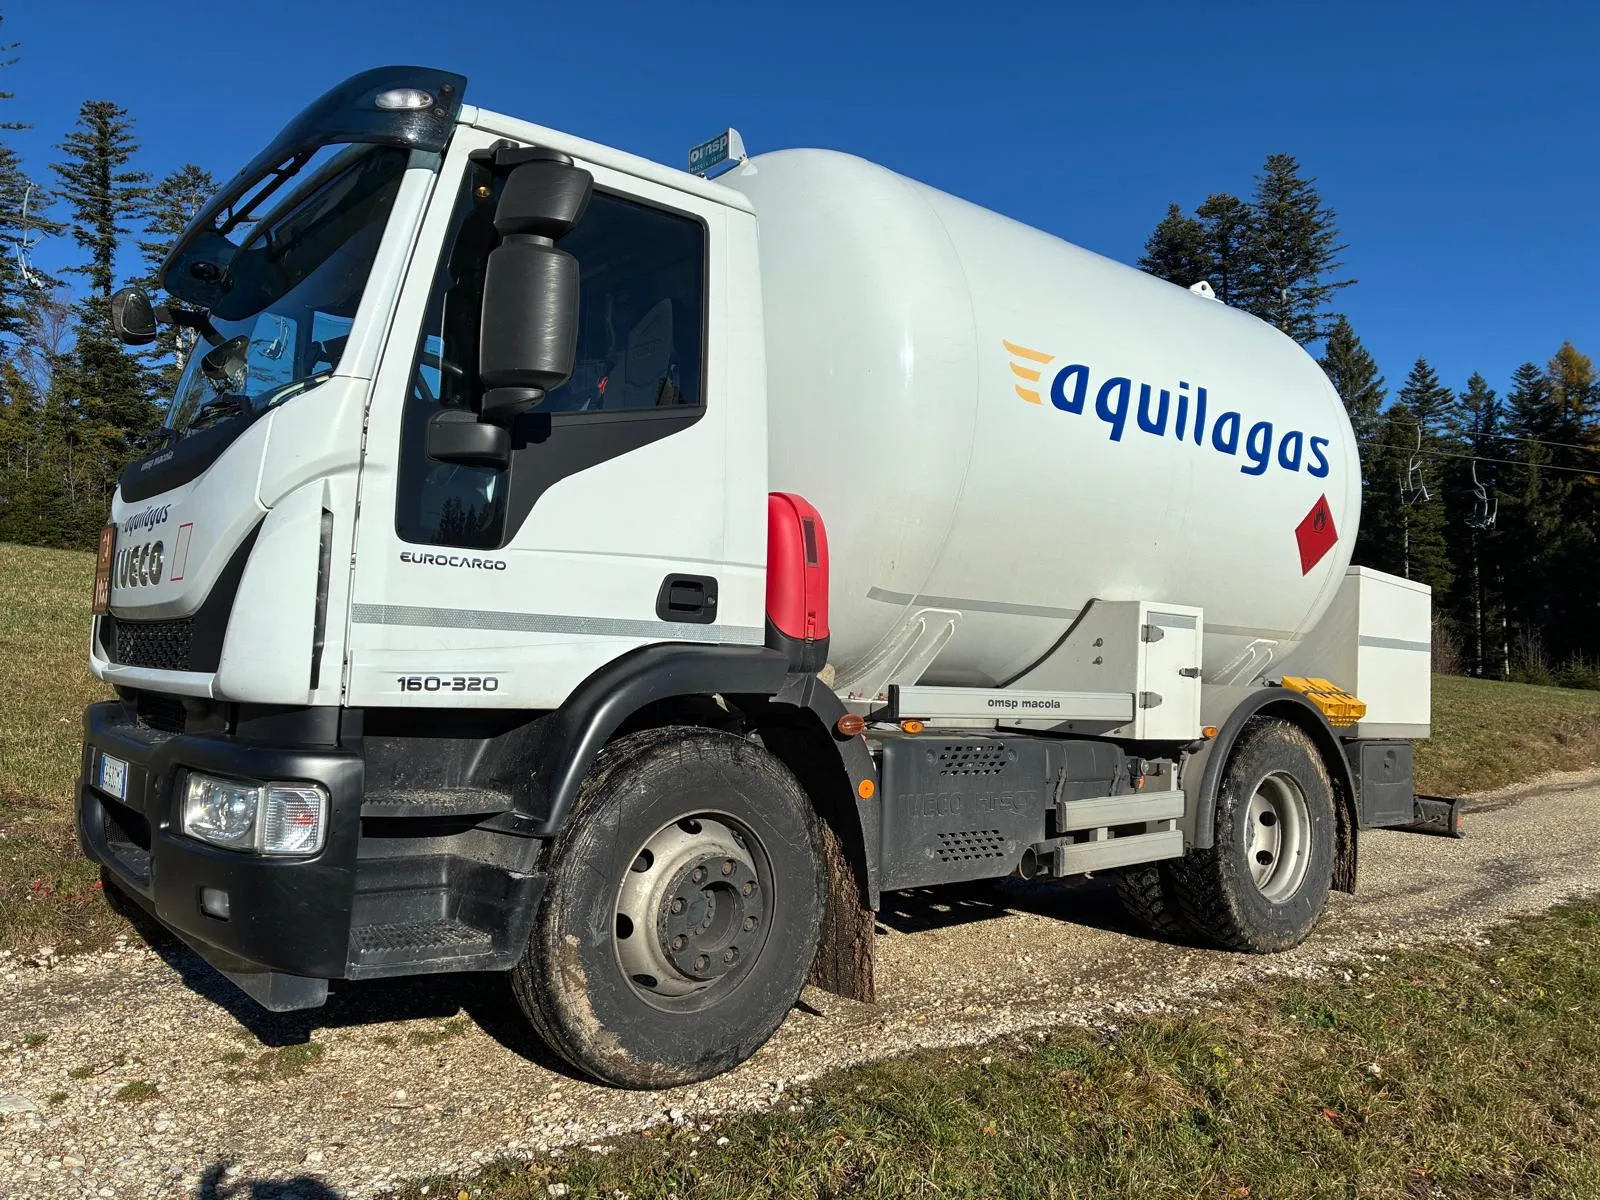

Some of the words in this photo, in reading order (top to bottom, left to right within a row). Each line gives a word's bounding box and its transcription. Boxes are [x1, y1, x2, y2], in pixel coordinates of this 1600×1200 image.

[690, 134, 728, 163] omsp
[1049, 363, 1330, 479] aquilagas
[123, 503, 172, 537] aquilagas
[113, 539, 166, 590] IVECO
[399, 551, 507, 571] EUROCARGO
[396, 676, 499, 692] 160-320
[987, 699, 1018, 709] omsp
[1021, 699, 1061, 709] macola
